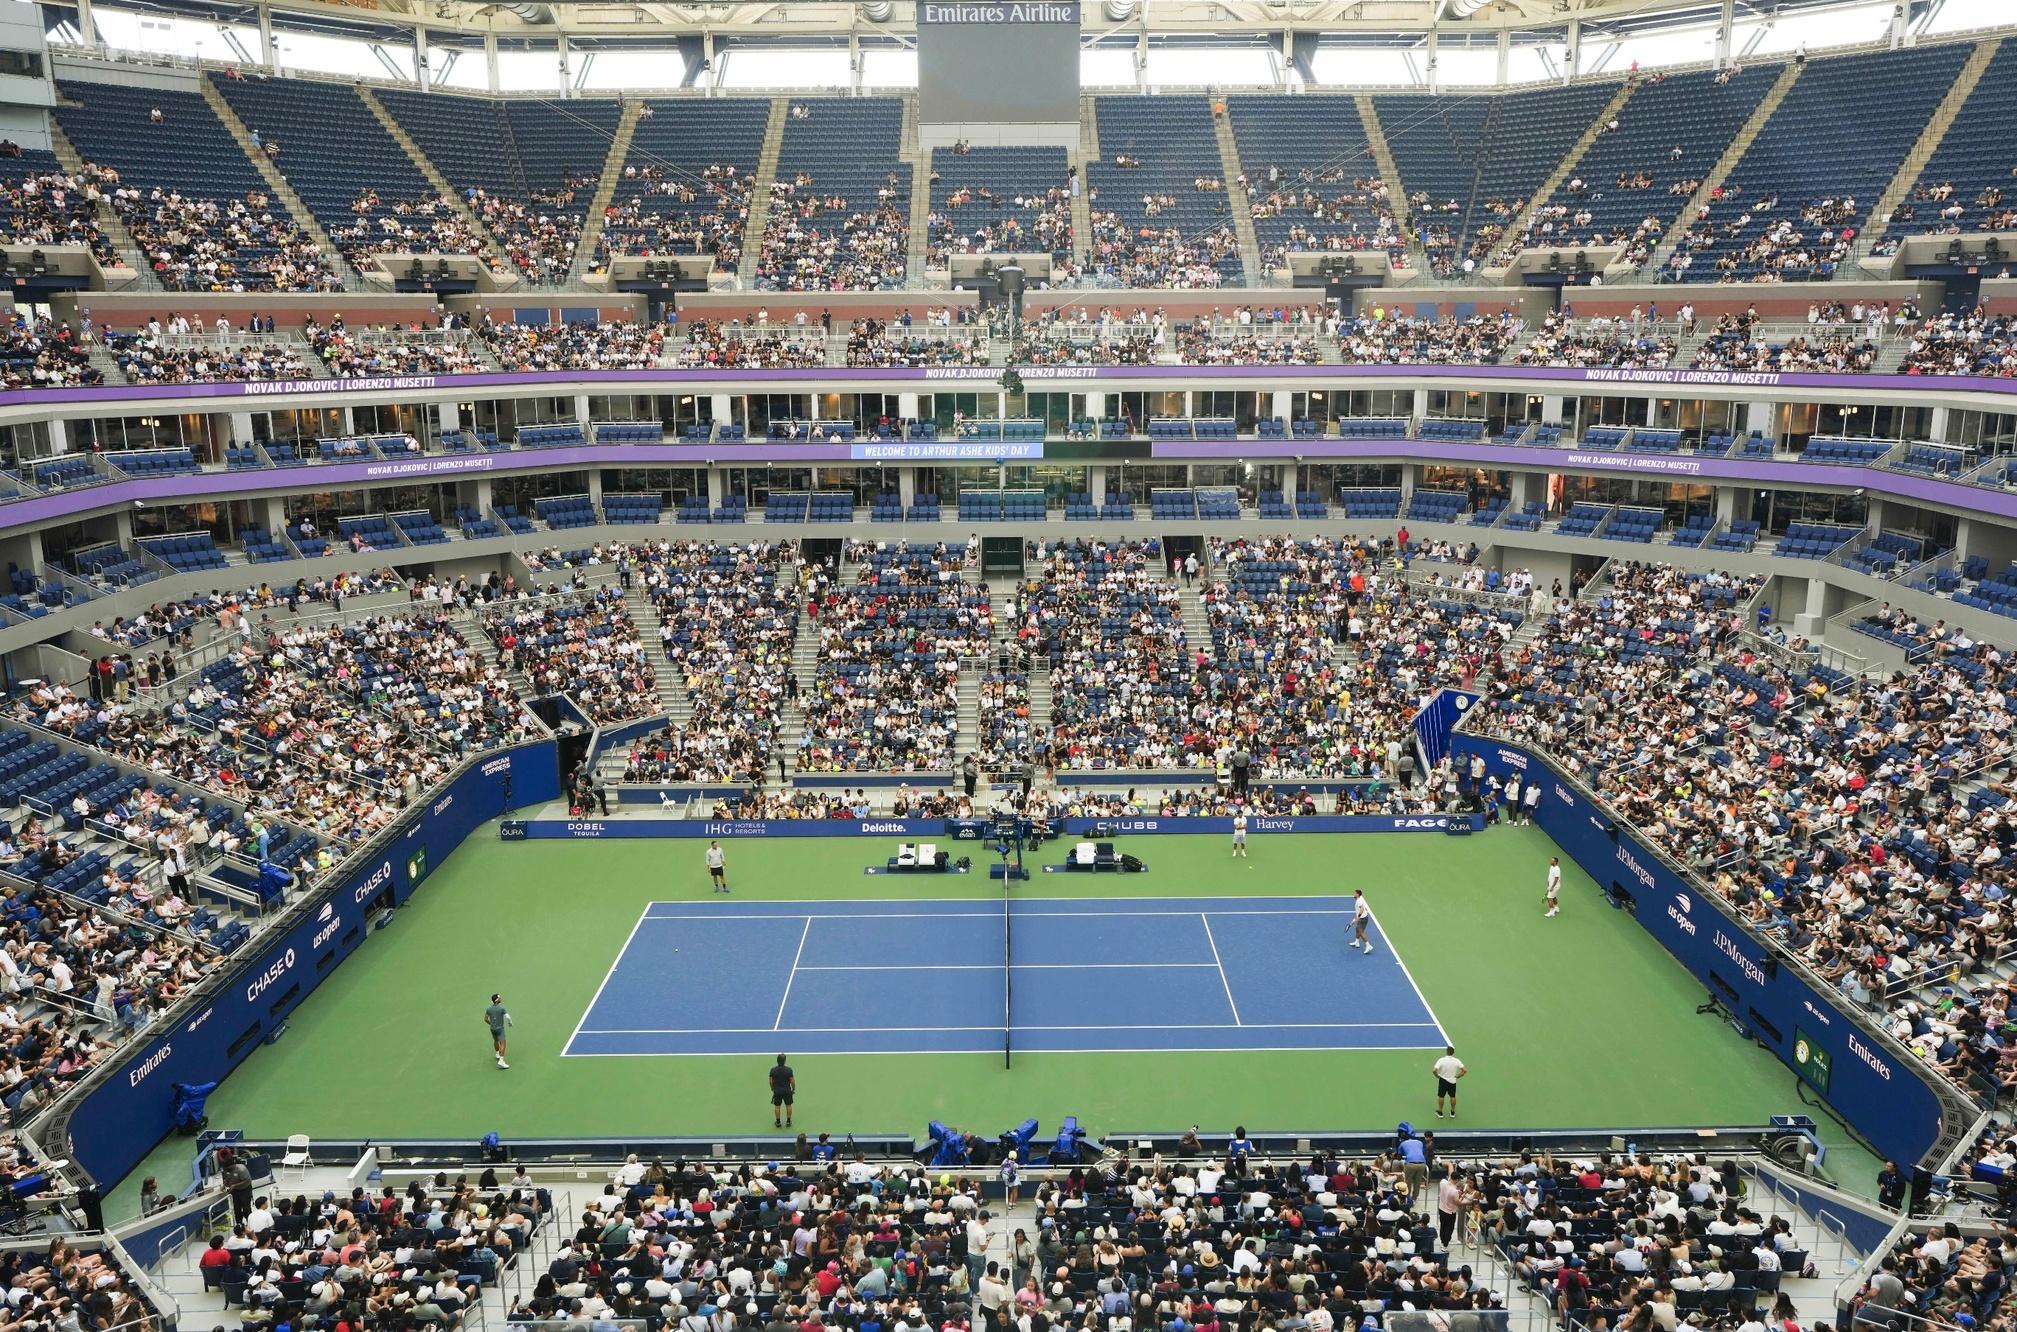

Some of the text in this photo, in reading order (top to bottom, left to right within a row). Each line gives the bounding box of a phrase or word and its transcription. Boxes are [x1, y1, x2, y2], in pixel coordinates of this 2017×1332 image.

[926, 4, 1072, 22] Emirates Airline
[926, 369, 960, 378] NOVAK
[1012, 368, 1054, 378] ORENZO
[1056, 368, 1097, 377] MUSETTI
[1586, 370, 1620, 380] NOVAK
[1622, 370, 1673, 382] DJOKOVIC
[1680, 372, 1729, 383] LORENZO
[1730, 373, 1780, 385] MUSETTI
[245, 382, 283, 393] NOVAK
[285, 380, 338, 392] DJOKOVIC
[346, 378, 391, 390] LORENZO
[393, 377, 435, 388] MUSETTI
[865, 445, 906, 456] WELCOME
[909, 445, 920, 456] TO
[921, 445, 957, 456] ARTHUR
[959, 445, 984, 456] ASHE
[1011, 445, 1030, 455] DAY
[367, 466, 392, 475] NOVAK
[393, 463, 428, 473] DJOKOVIC
[433, 460, 463, 470] LORENZO
[465, 458, 493, 468] MUSETTI
[1568, 455, 1591, 464] NOVAK
[1592, 457, 1628, 466] DJOKOVIC
[1633, 459, 1666, 468] LORENZO
[1667, 460, 1700, 471] MUSETTI
[481, 756, 510, 772] AMERICAN
[1497, 749, 1528, 764] AMERICAN
[1502, 756, 1528, 770] EXPRESS
[485, 762, 511, 776] EXPRESS
[705, 823, 732, 834] IHG
[862, 823, 906, 832] Deloitte.
[1256, 818, 1294, 830] Harvey
[355, 868, 383, 903] CHASE
[1667, 904, 1696, 936] us open
[313, 916, 340, 949] us open
[1713, 929, 1766, 986] J.P.Morgan
[247, 957, 285, 1002] CHASE
[1848, 1033, 1891, 1080] Emirates
[129, 1043, 171, 1087] Emirates
